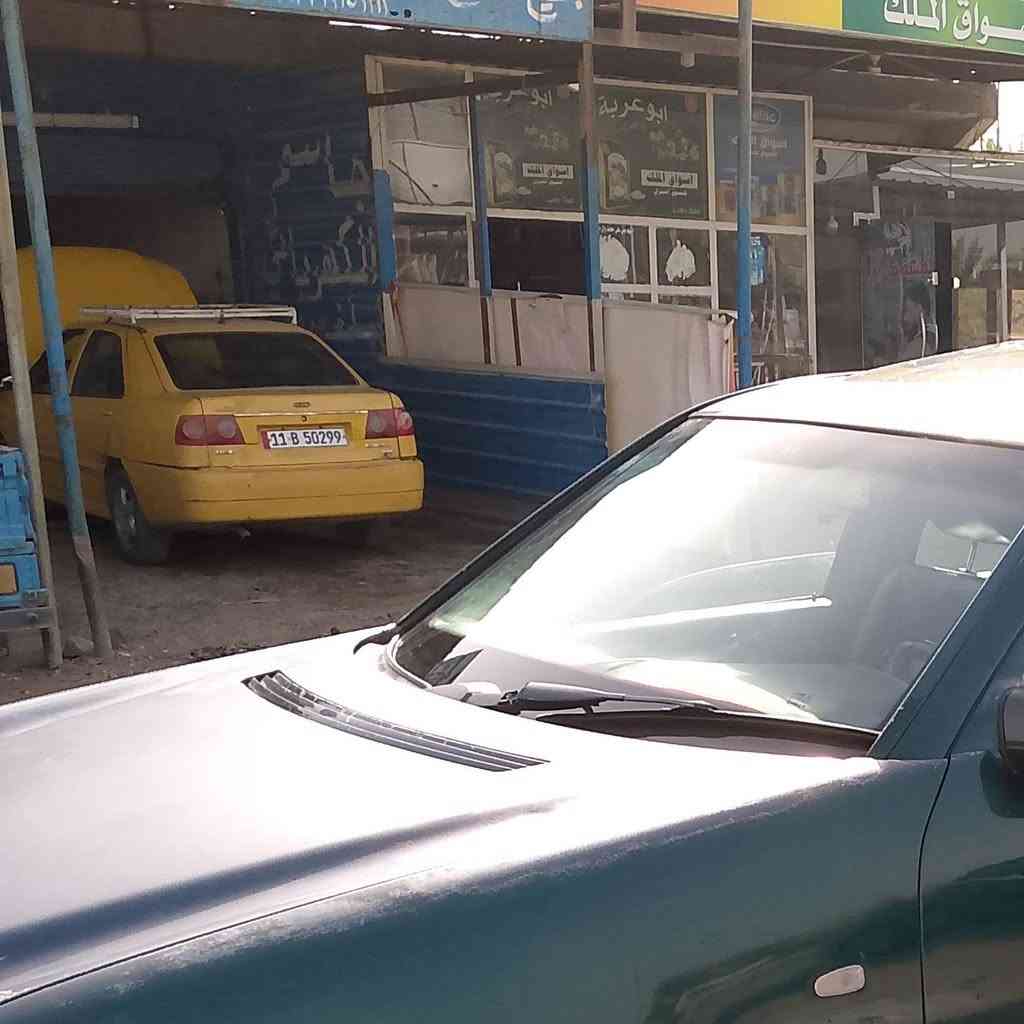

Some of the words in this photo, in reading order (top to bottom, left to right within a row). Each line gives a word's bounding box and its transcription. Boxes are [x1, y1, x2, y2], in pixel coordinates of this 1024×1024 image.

[271, 433, 287, 447] 11
[290, 431, 300, 446] B
[304, 430, 342, 446] 50299
